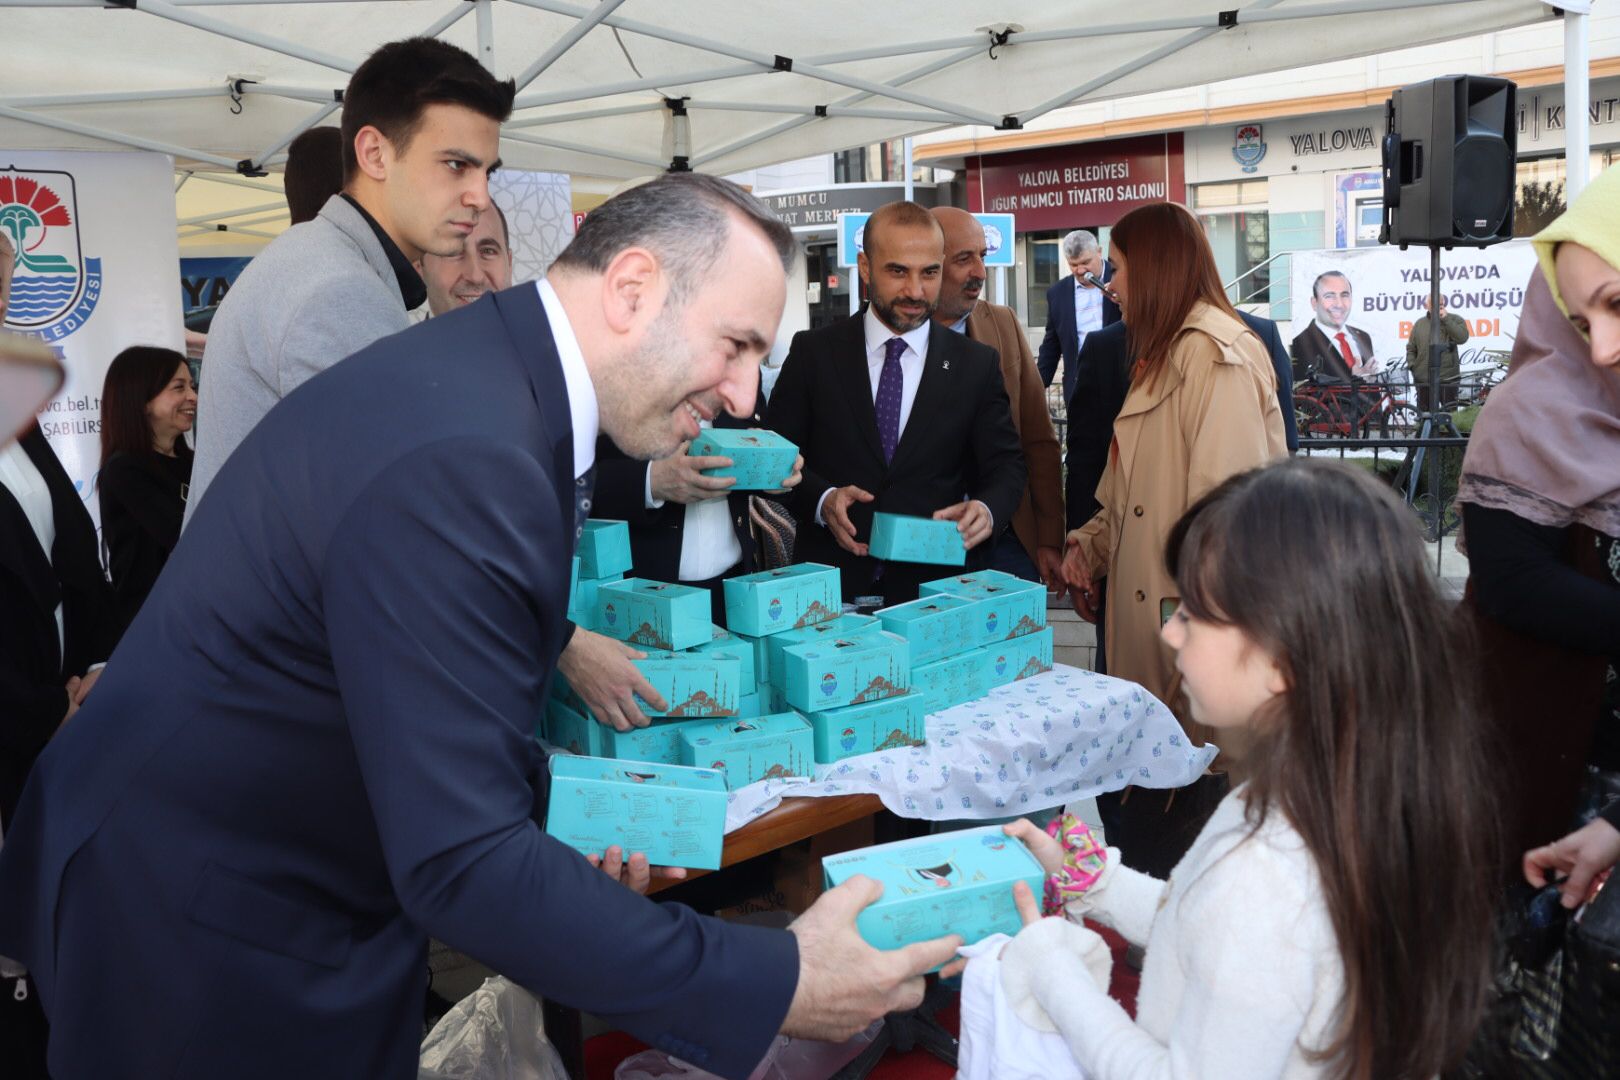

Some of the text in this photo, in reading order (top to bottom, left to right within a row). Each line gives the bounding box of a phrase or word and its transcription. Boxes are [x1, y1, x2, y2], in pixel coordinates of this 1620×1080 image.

[1289, 127, 1375, 155] YALOVA
[1547, 98, 1618, 129] KNT
[1018, 159, 1129, 188] YALOVA BELEDİYESİ
[778, 193, 827, 209] MUMCU
[1021, 191, 1063, 208] MUMCU
[1067, 186, 1114, 205] TİYATRO
[1117, 182, 1165, 200] SALONU
[1363, 292, 1427, 312] BÜYÜK
